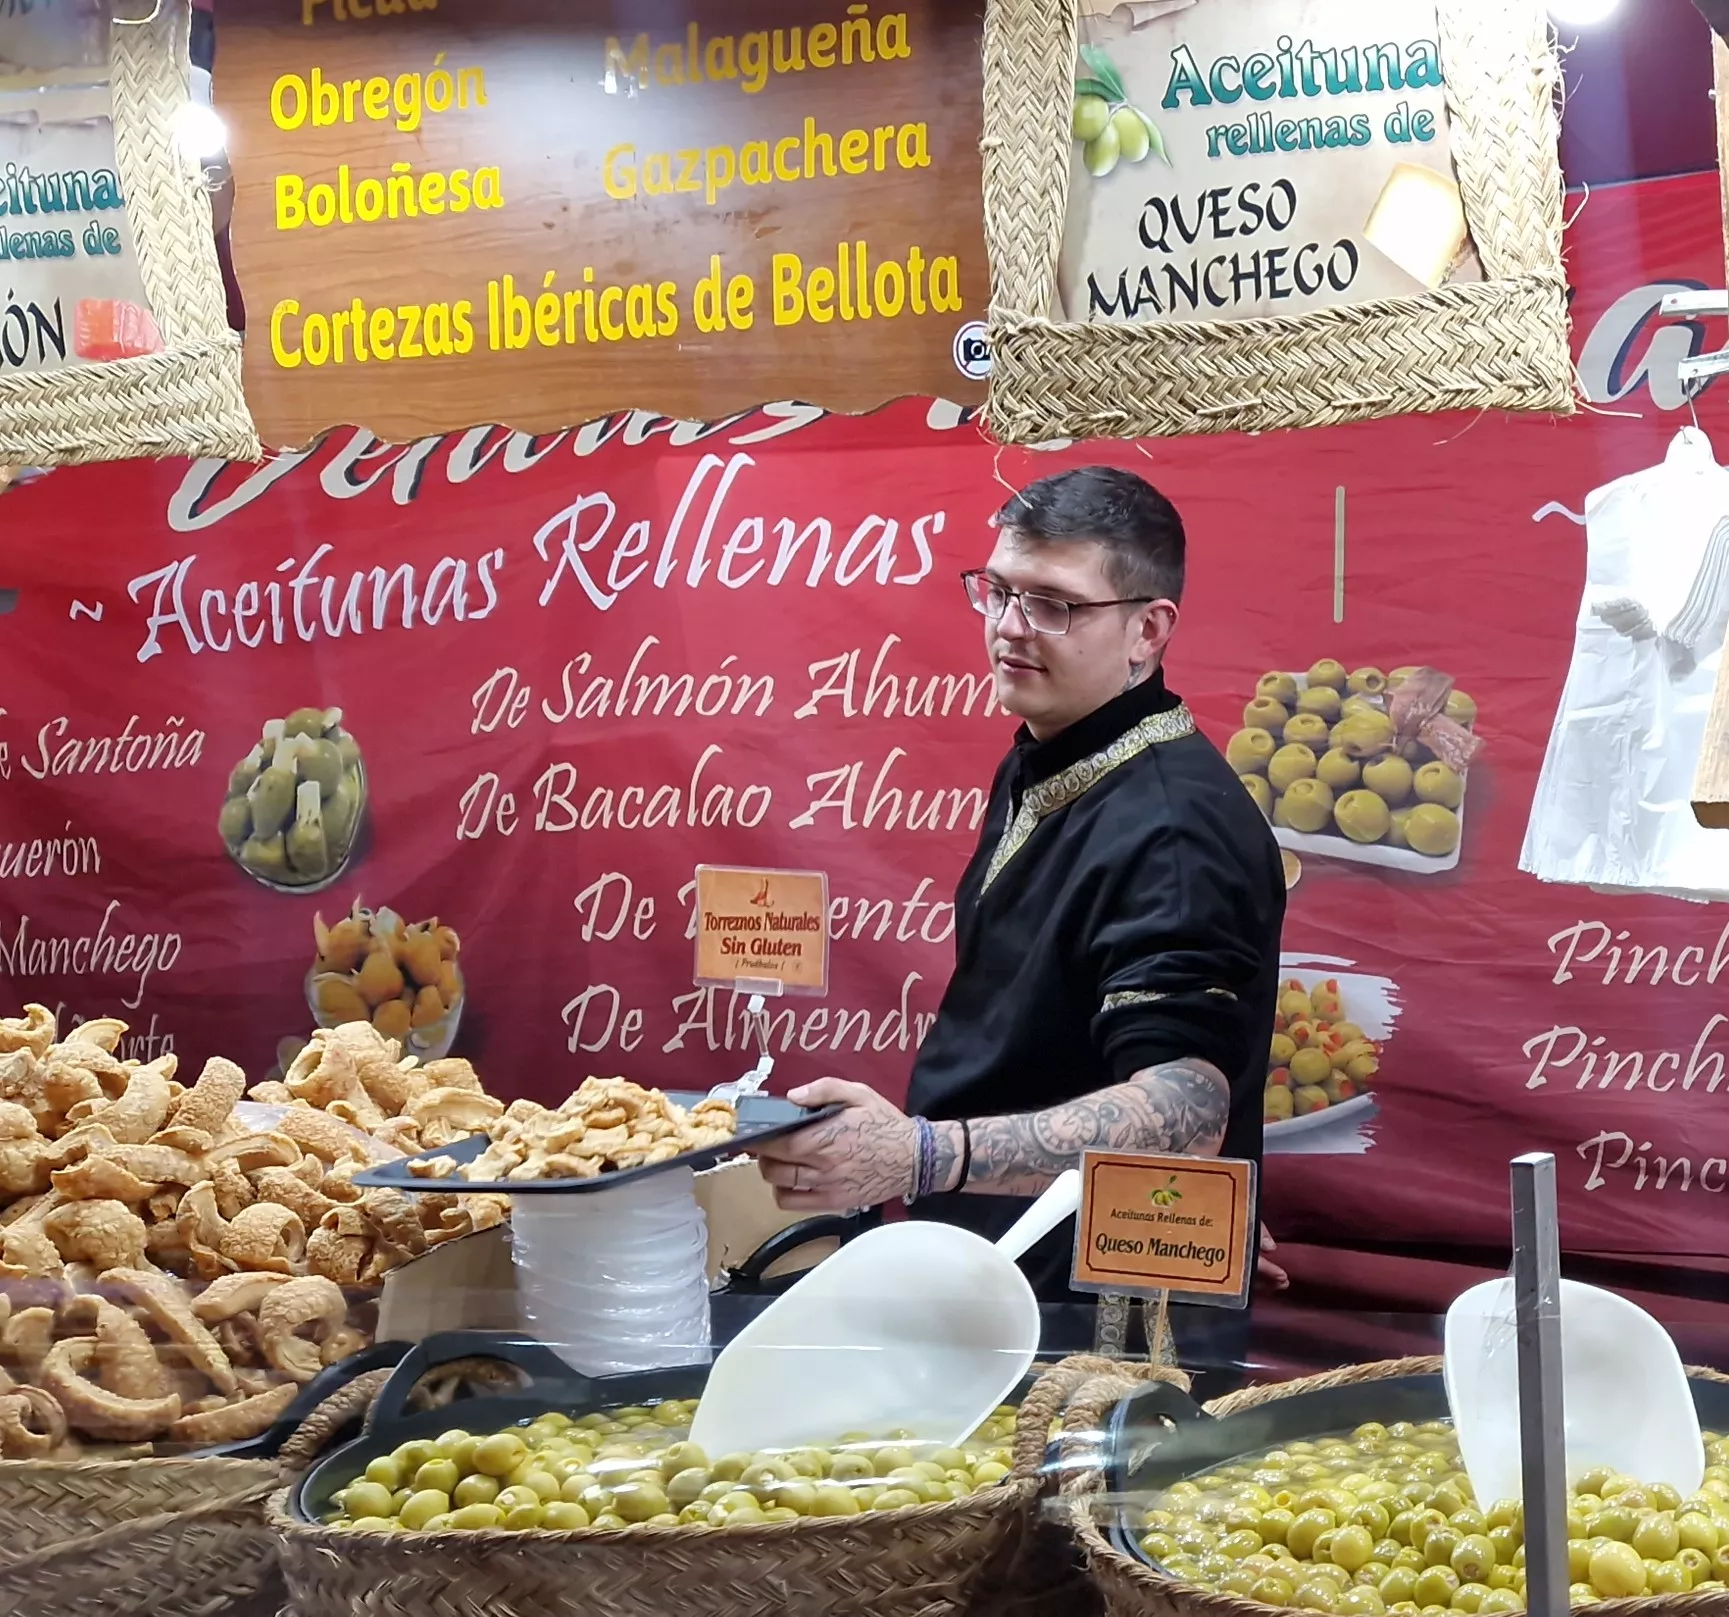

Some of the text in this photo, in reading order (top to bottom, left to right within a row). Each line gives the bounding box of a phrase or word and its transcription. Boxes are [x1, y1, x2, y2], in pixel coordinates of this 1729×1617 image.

[599, 4, 911, 96] Malagueña
[1161, 35, 1444, 109] Aceituna
[270, 52, 488, 133] Obregón
[602, 116, 931, 204] Gazpachera
[1207, 102, 1435, 158] rellenas de
[0, 162, 125, 216] ituna
[275, 162, 503, 230] Boloñesa
[1138, 178, 1297, 253] QUESO
[0, 220, 122, 260] lenas de
[271, 241, 962, 367] Cortezas Ibéricas de Bellota
[1086, 238, 1360, 322] MANCHEGO
[0, 288, 66, 368] ÓN
[127, 543, 503, 663] Aceitunas
[533, 453, 945, 611] Rellenas
[471, 634, 1011, 734] De Salmón Ahum
[21, 715, 206, 780] Santoña
[455, 744, 989, 840] De Bacalao Ahum
[0, 820, 100, 878] uerón
[574, 872, 656, 942] De
[704, 911, 820, 932] Torreznos Naturales
[720, 935, 802, 957] Sin Gluten
[561, 972, 938, 1054] De Almendr
[1096, 1233, 1225, 1267] Queso Manchego
[1110, 1208, 1155, 1222] Aceitunas
[1157, 1212, 1196, 1226] Rellenas
